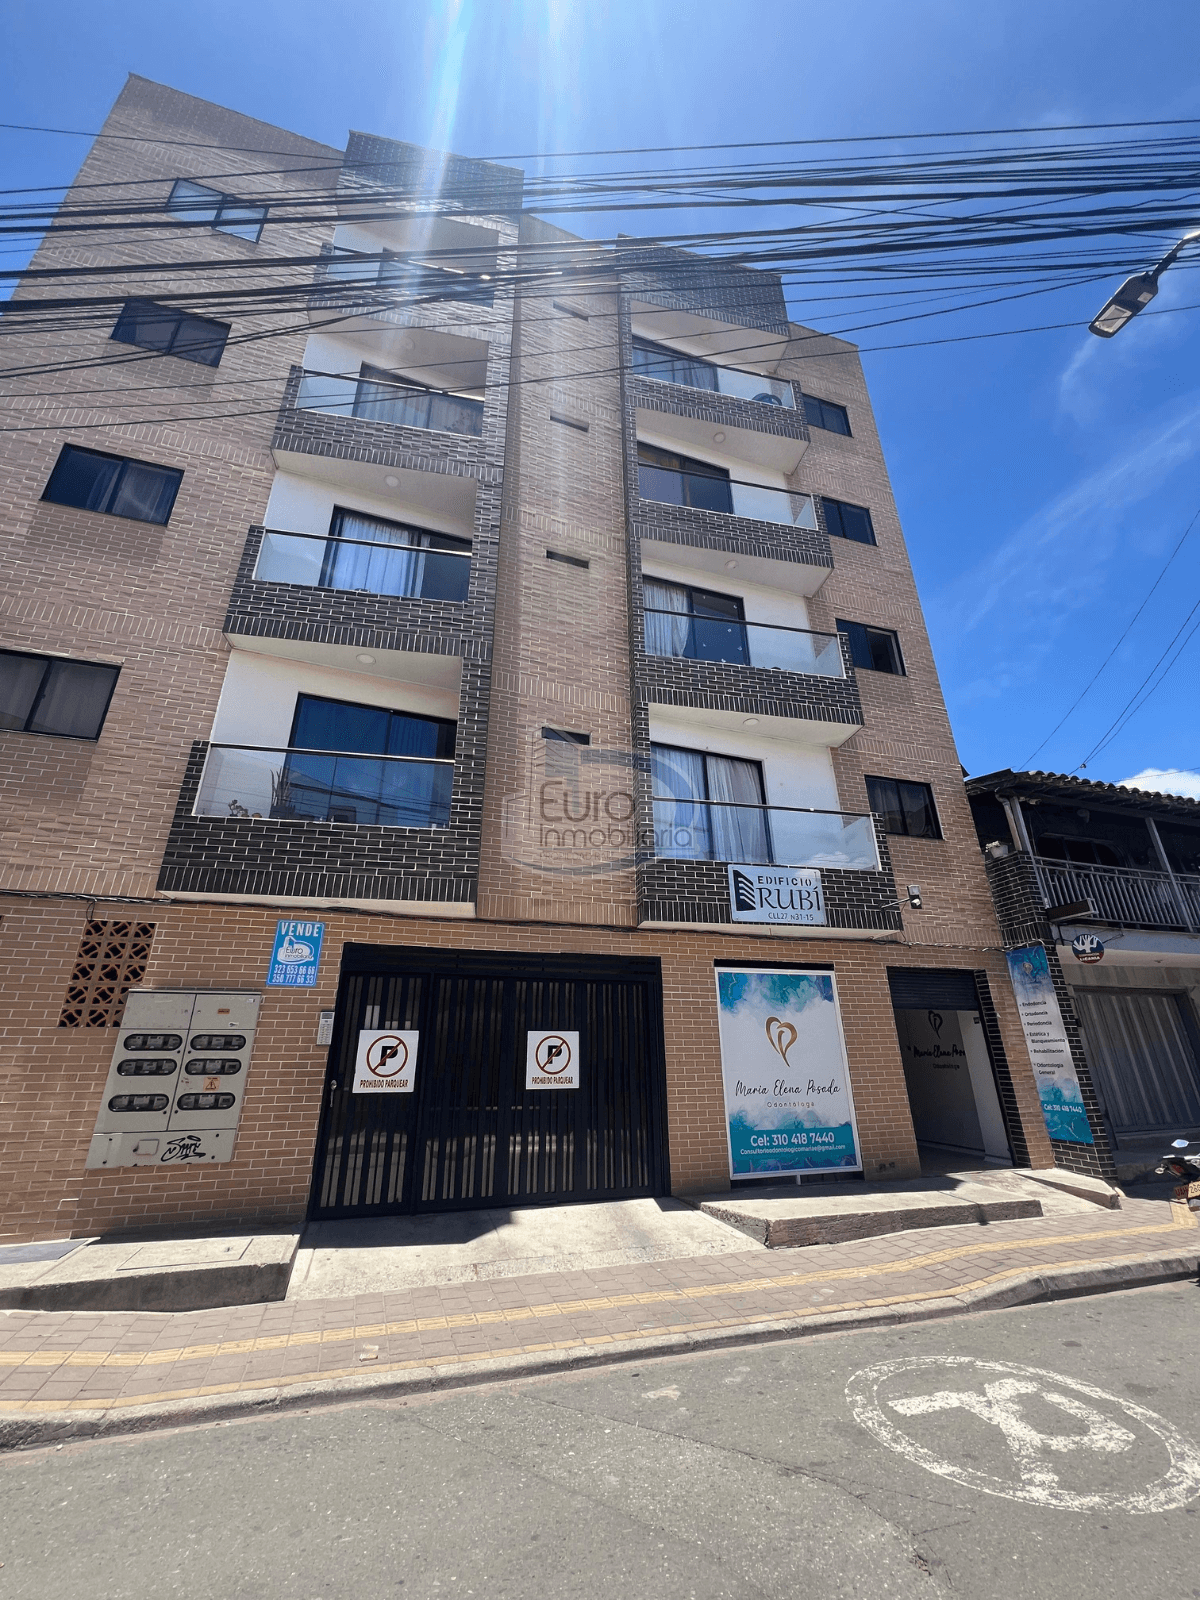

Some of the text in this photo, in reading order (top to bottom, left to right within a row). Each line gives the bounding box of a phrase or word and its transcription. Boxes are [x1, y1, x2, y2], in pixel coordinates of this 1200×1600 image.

[757, 875, 812, 887] EDIFICIO
[755, 886, 821, 911] RUBÍ
[281, 922, 320, 936] VENDE
[285, 974, 297, 983] 777
[773, 1079, 802, 1096] Elena
[806, 1079, 840, 1096] Posada
[750, 1131, 835, 1147] Cel: 310 418 7440
